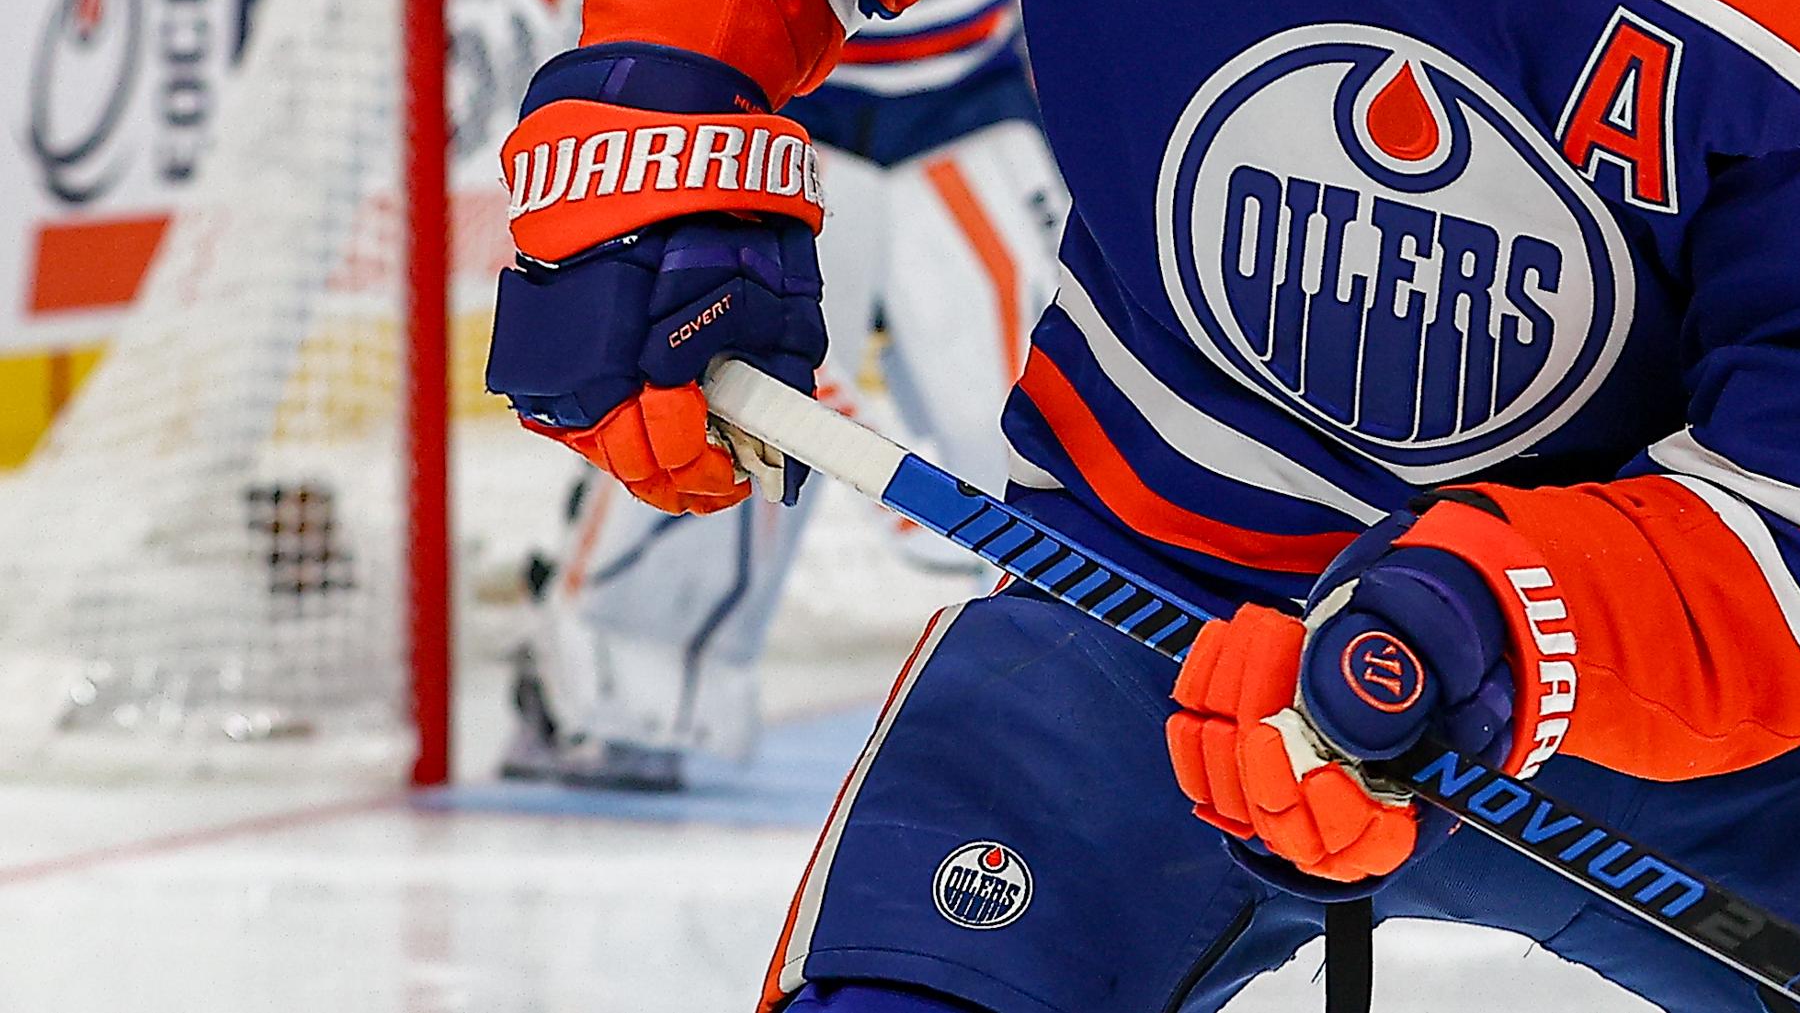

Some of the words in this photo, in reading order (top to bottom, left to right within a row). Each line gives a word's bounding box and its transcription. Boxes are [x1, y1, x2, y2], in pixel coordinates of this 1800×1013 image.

[1555, 6, 1684, 214] A
[669, 294, 732, 349] COVERT
[1220, 164, 1563, 443] OILERS
[1504, 566, 1578, 781] WAR
[944, 866, 1021, 923] OILERS
[1412, 751, 1706, 918] NOVIUM
